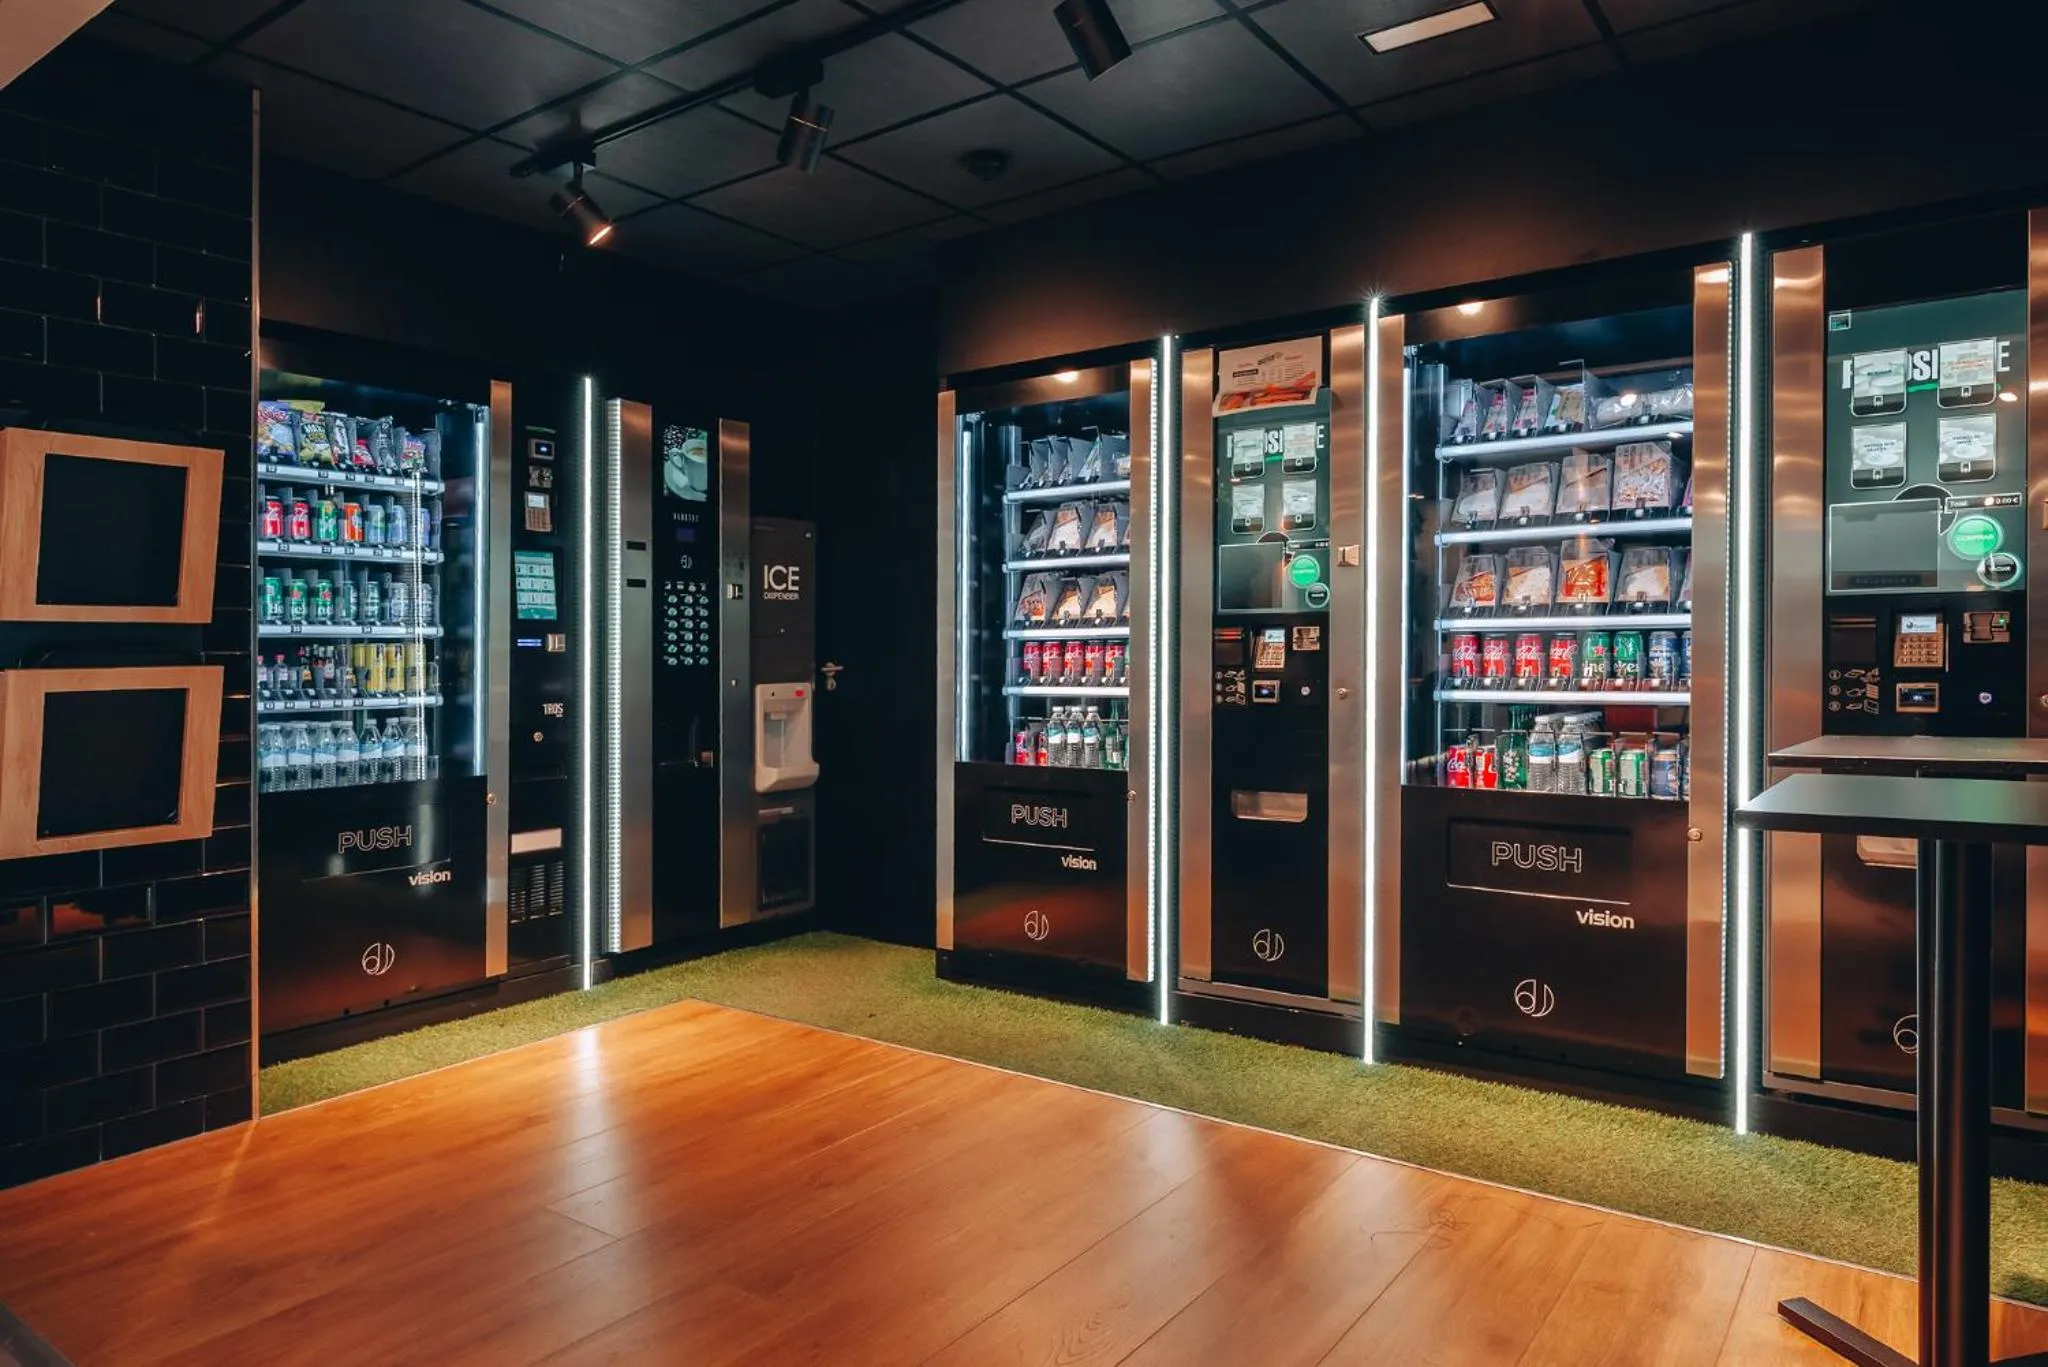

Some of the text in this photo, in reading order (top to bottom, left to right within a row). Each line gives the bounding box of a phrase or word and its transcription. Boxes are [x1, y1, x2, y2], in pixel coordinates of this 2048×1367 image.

[763, 564, 800, 591] ICE
[1011, 804, 1068, 829] PUSH
[338, 826, 413, 854] PUSH
[1061, 854, 1097, 872] vision
[1491, 841, 1582, 874] PUSH
[408, 870, 452, 887] vision
[1575, 908, 1635, 930] vision
